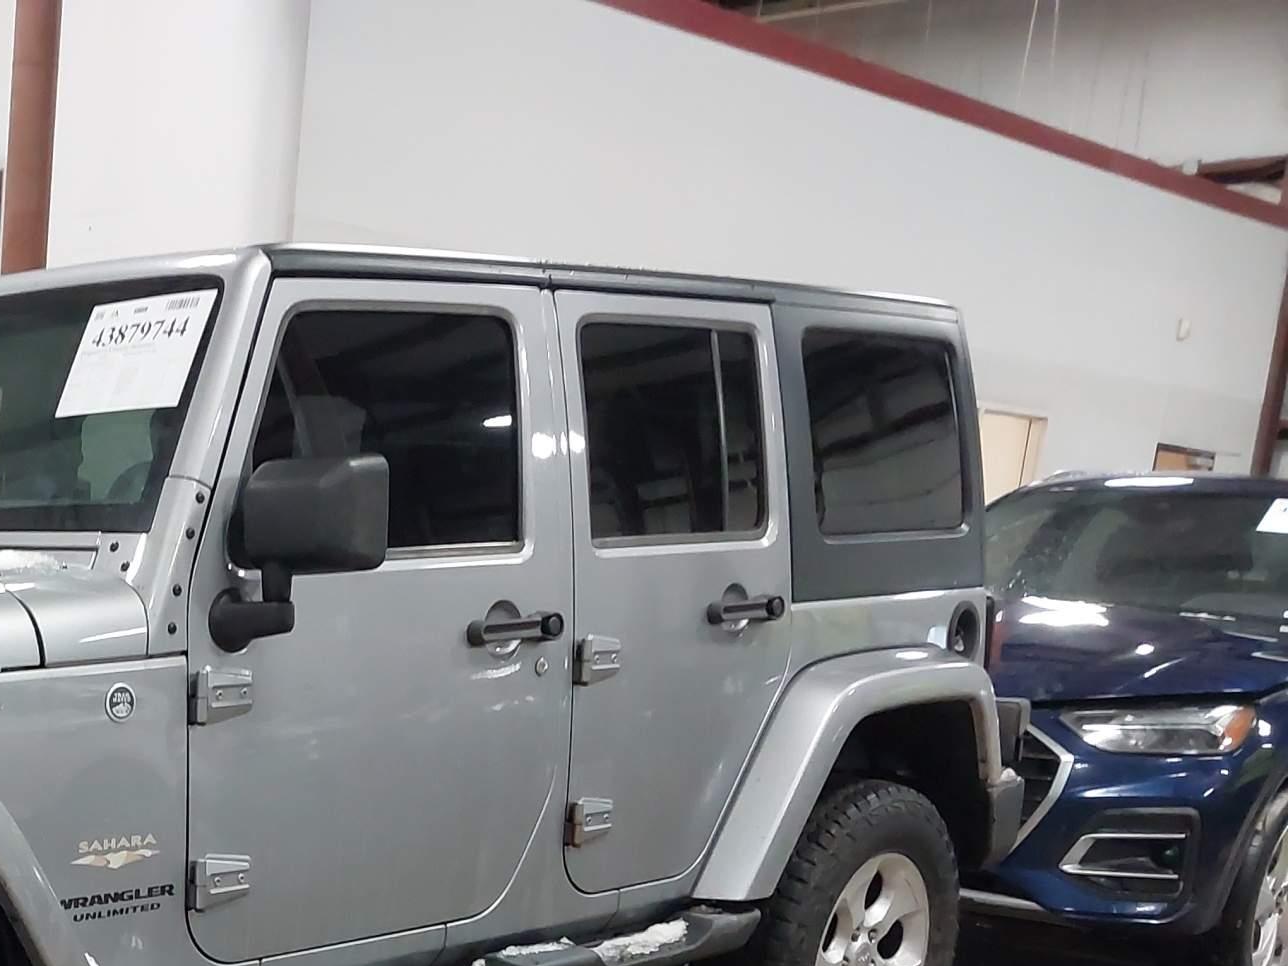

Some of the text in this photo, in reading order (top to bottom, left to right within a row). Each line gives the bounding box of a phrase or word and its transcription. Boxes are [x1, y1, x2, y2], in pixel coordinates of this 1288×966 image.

[92, 316, 190, 347] 43879744
[78, 833, 157, 853] SAHARA
[73, 902, 161, 922] UNLIMITED
